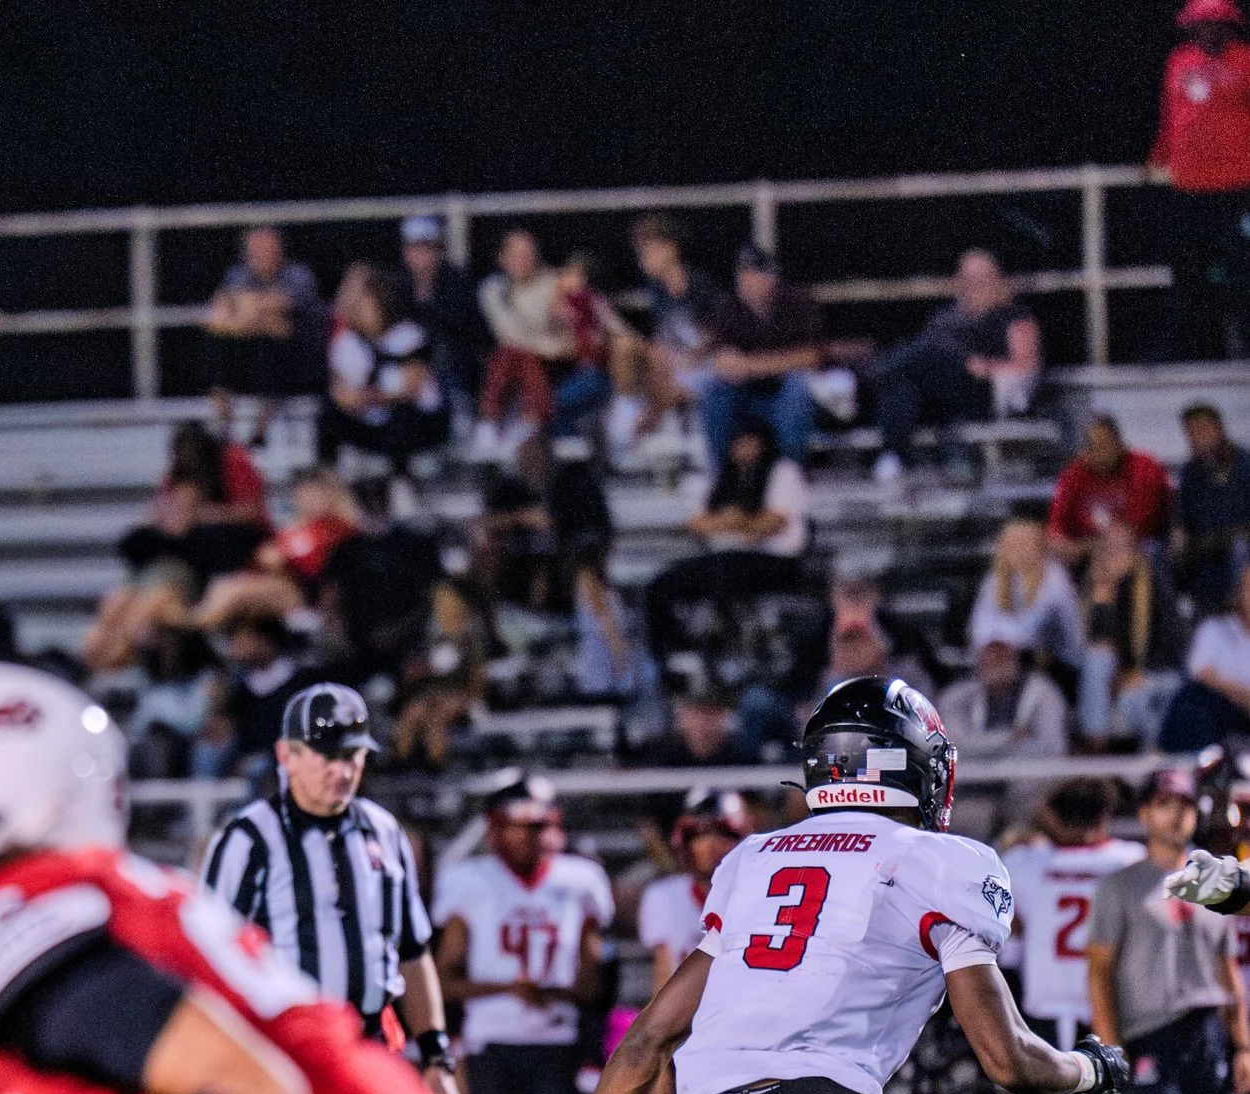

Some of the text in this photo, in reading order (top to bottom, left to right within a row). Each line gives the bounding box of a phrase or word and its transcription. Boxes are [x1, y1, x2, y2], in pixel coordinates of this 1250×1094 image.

[817, 789, 885, 804] Riddell
[758, 833, 876, 853] FIREBIRDS
[743, 866, 831, 972] 3
